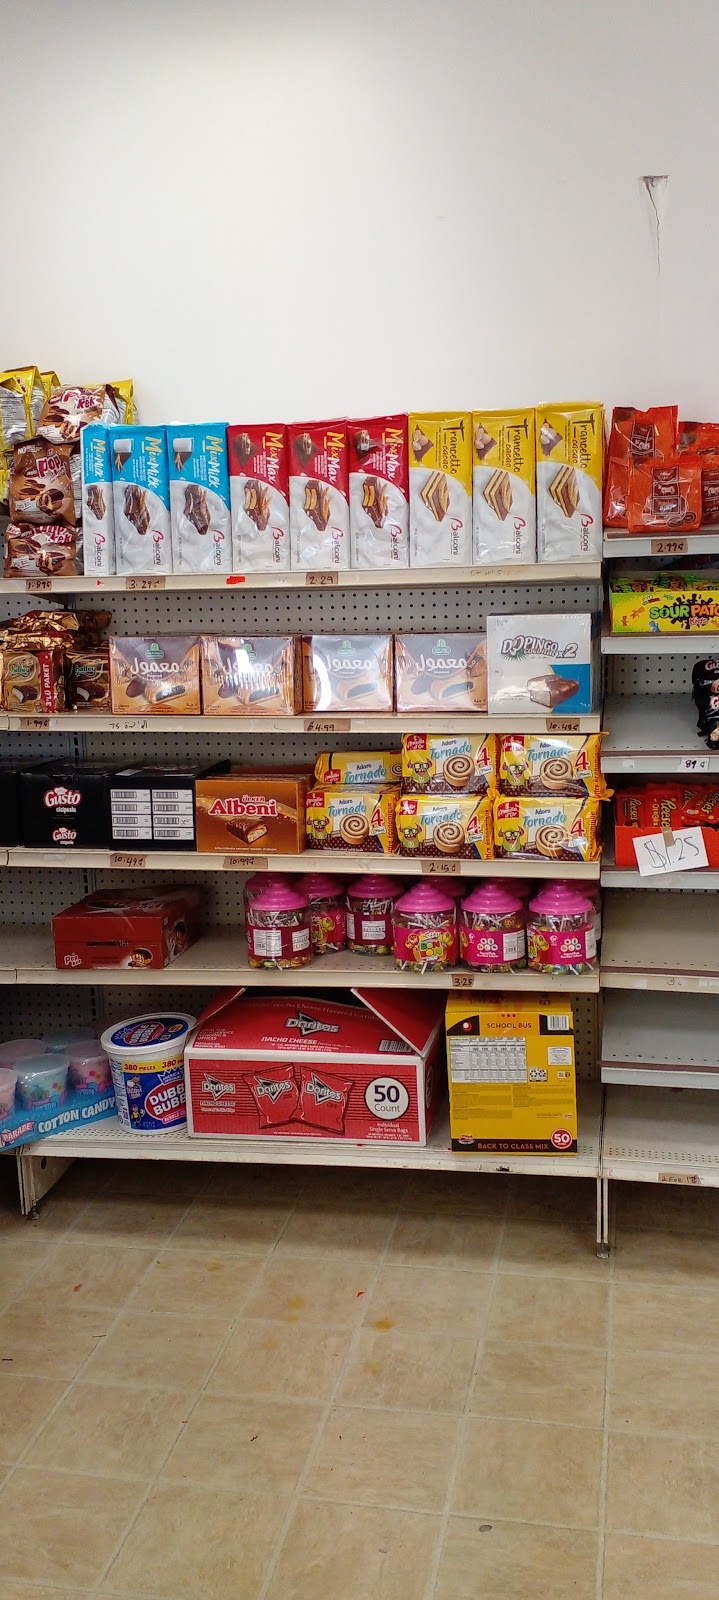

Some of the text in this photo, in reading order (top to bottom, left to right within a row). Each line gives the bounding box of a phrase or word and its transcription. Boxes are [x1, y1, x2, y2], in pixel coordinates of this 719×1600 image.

[443, 419, 466, 475] Trancetto
[506, 417, 528, 473] Trancetto
[572, 412, 596, 469] Trancetto
[450, 517, 463, 556] Balconi
[513, 516, 526, 555] Balconi
[580, 513, 594, 552] Balconi
[151, 529, 164, 566] Balconi
[212, 529, 225, 566] Balconi
[271, 526, 284, 563] Balconi
[331, 526, 344, 564] Balconi
[389, 524, 403, 561] Balconi
[649, 605, 690, 620] SOUR
[501, 634, 559, 656] DOPINGO
[130, 657, 180, 675] معمول
[415, 654, 467, 672] معمول
[430, 741, 472, 760] Tornado
[477, 747, 490, 766] 4
[575, 750, 590, 770] 4
[344, 765, 387, 783] Tornado
[356, 763, 372, 771] Adore
[44, 789, 81, 808] Gusto
[208, 798, 278, 816] Albeni
[328, 802, 367, 817] Tornado
[371, 808, 384, 827] 4
[523, 811, 567, 828] Tornado
[570, 818, 585, 837] 4
[52, 828, 77, 841] Gusto
[454, 977, 474, 987] 3.25
[285, 1017, 341, 1034] Doritos
[289, 1037, 318, 1045] CHEESE
[124, 1063, 138, 1071] 380
[161, 1059, 177, 1069] 380
[202, 1080, 236, 1094] Doritos
[255, 1079, 293, 1098] Doritos
[305, 1081, 343, 1102] Doritos
[374, 1085, 401, 1103] 50
[38, 1096, 116, 1133] COTTON CANDY
[374, 1103, 401, 1113] Count
[554, 1133, 569, 1143] 50
